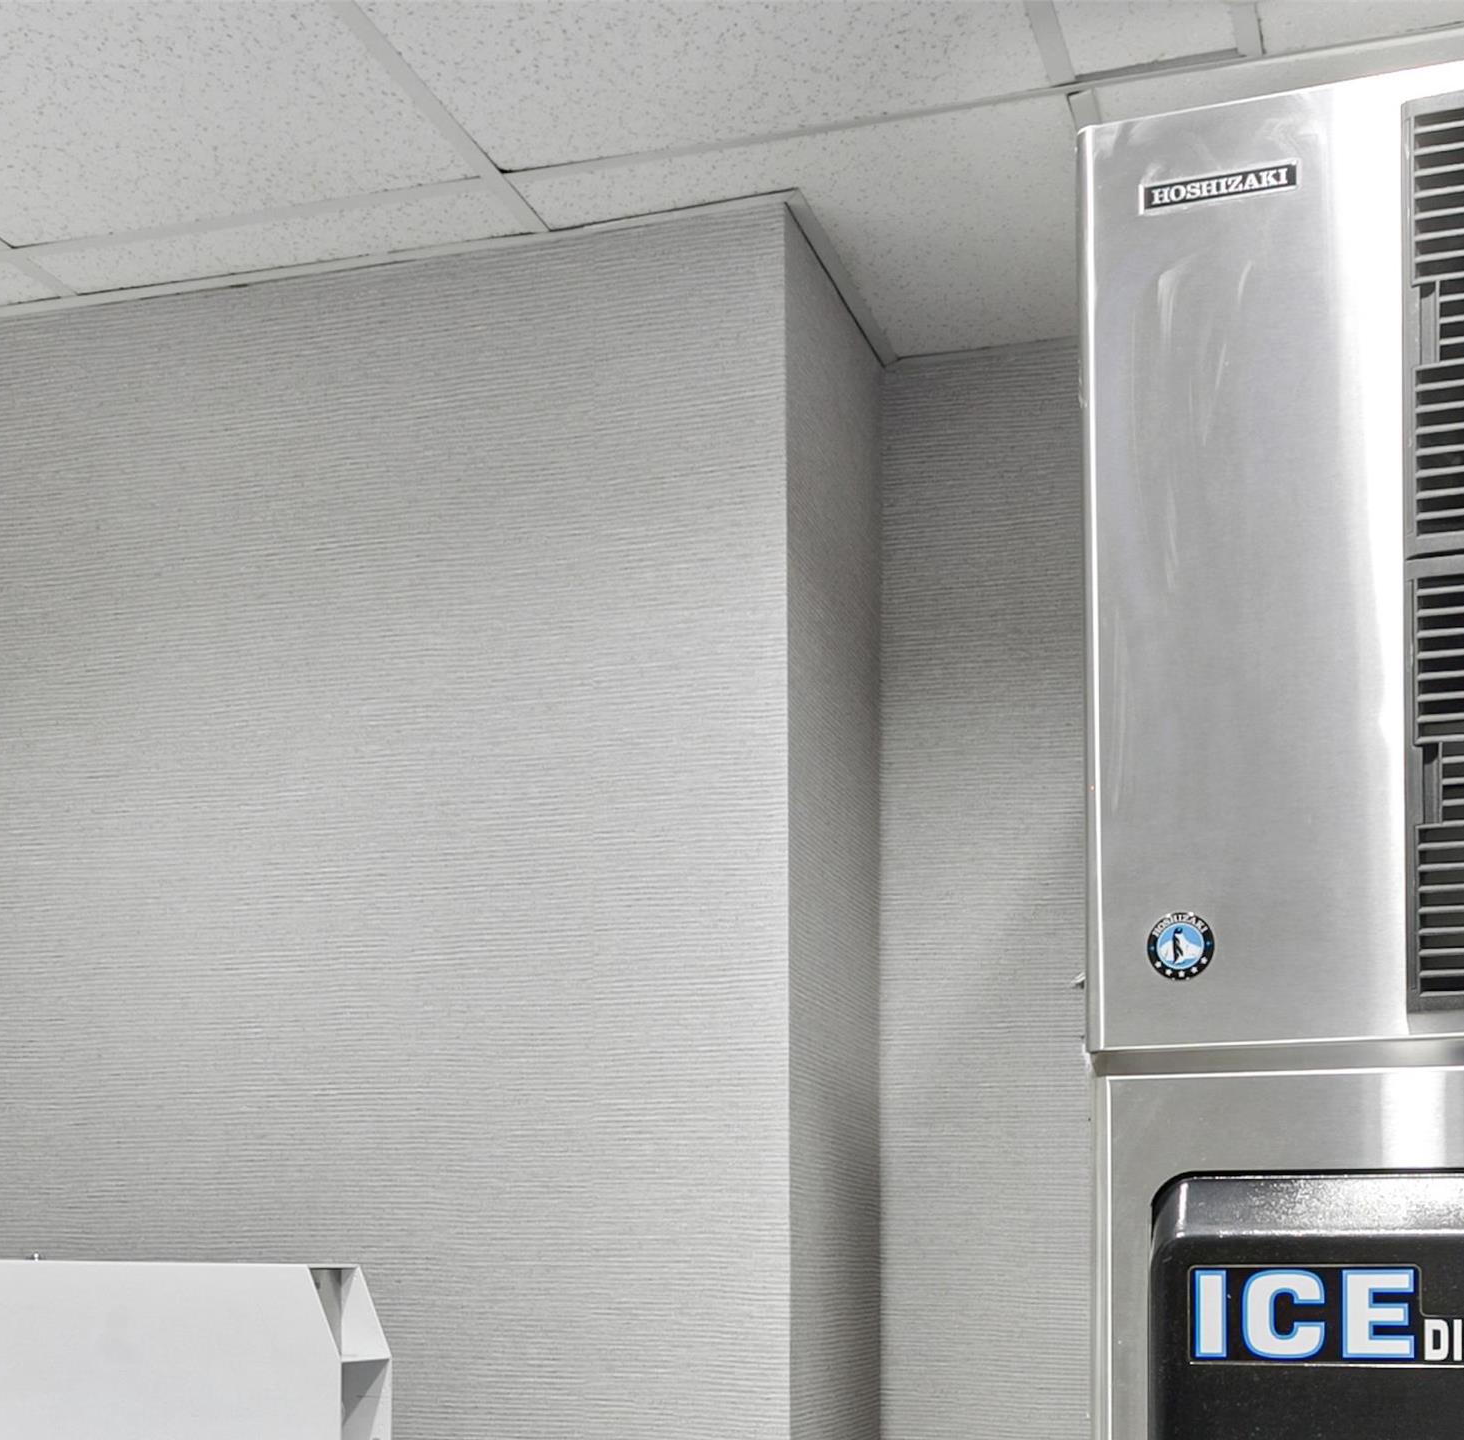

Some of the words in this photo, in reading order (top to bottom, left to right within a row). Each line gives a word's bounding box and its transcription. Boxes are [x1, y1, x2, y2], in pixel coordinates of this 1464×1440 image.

[1151, 167, 1288, 205] HOSHIZAKI
[1152, 914, 1208, 937] HOSHIZAKI
[1193, 1267, 1416, 1360] ICE
